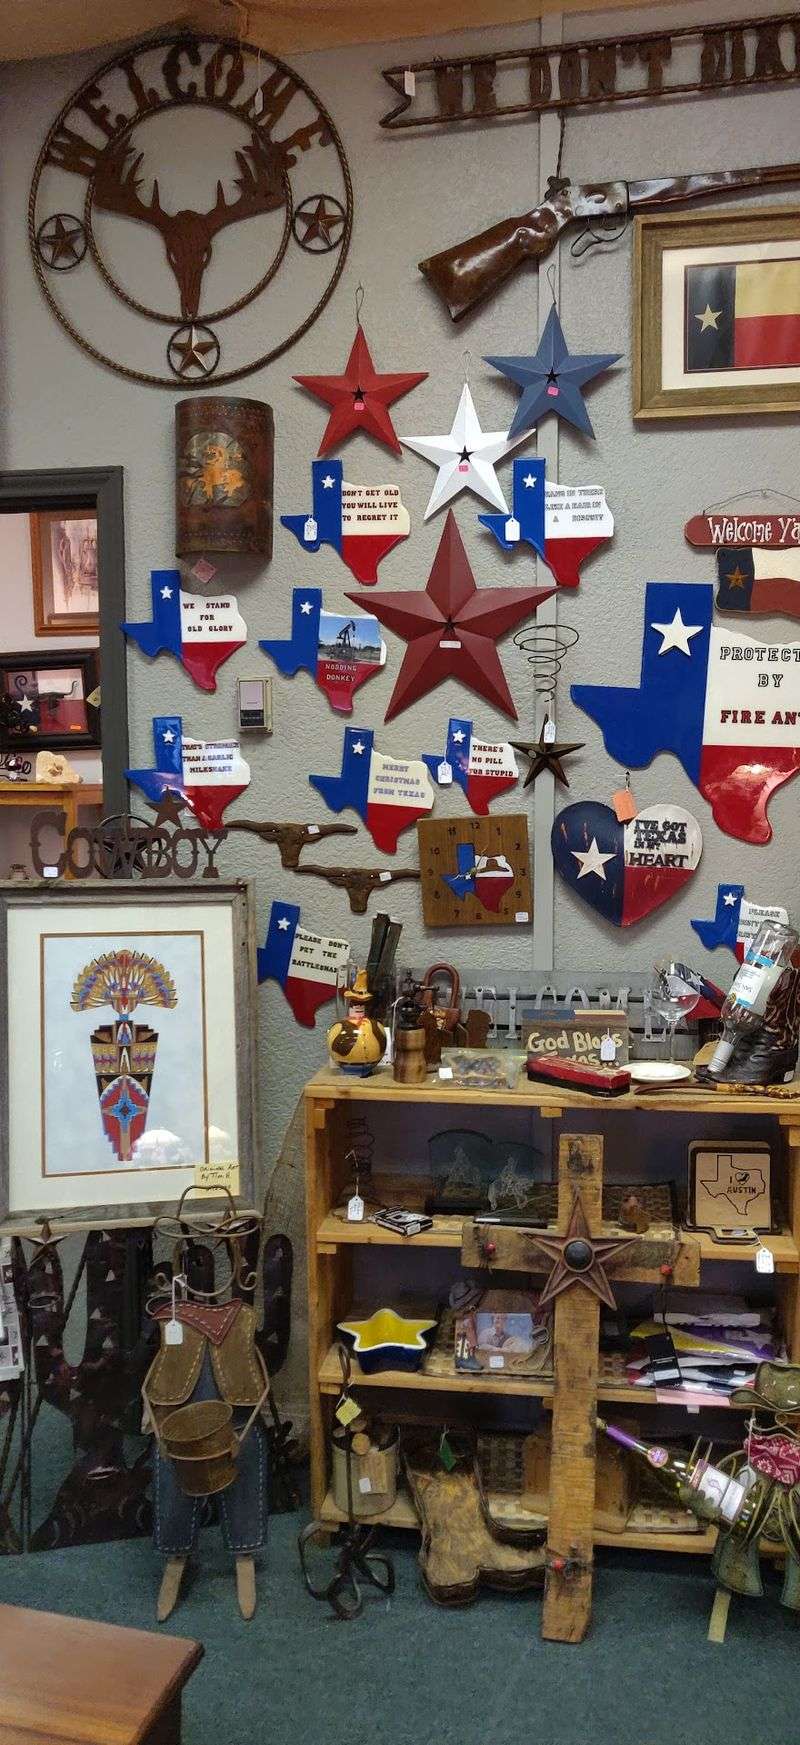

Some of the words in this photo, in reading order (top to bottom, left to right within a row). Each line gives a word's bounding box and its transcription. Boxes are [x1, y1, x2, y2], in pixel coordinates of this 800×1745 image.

[433, 60, 498, 116] WE
[528, 36, 672, 103] DON'T
[45, 42, 335, 178] WELCOME
[341, 489, 362, 497] DON'T
[707, 516, 773, 544] Welcome
[325, 663, 357, 671] NODDING
[326, 674, 355, 682] DONKEY
[757, 673, 784, 688] BY
[720, 709, 766, 725] FIRE
[771, 710, 800, 725] AN
[472, 744, 504, 753] THERE'S
[485, 757, 503, 765] PILL
[189, 765, 233, 773] MILKSHAKE
[382, 764, 410, 773] MERRY
[376, 775, 420, 786] CHRISTMAS
[397, 789, 425, 799] TEXAS
[662, 820, 688, 833] GOT
[634, 829, 687, 844] TEXAS
[29, 809, 229, 879] COWBOY
[629, 852, 689, 867] HEART
[295, 933, 322, 944] PLEASE
[328, 940, 349, 950] DON'T
[299, 945, 315, 954] PET
[322, 950, 338, 959] THE
[527, 1029, 570, 1053] God
[726, 1186, 757, 1195] AUSTIN
